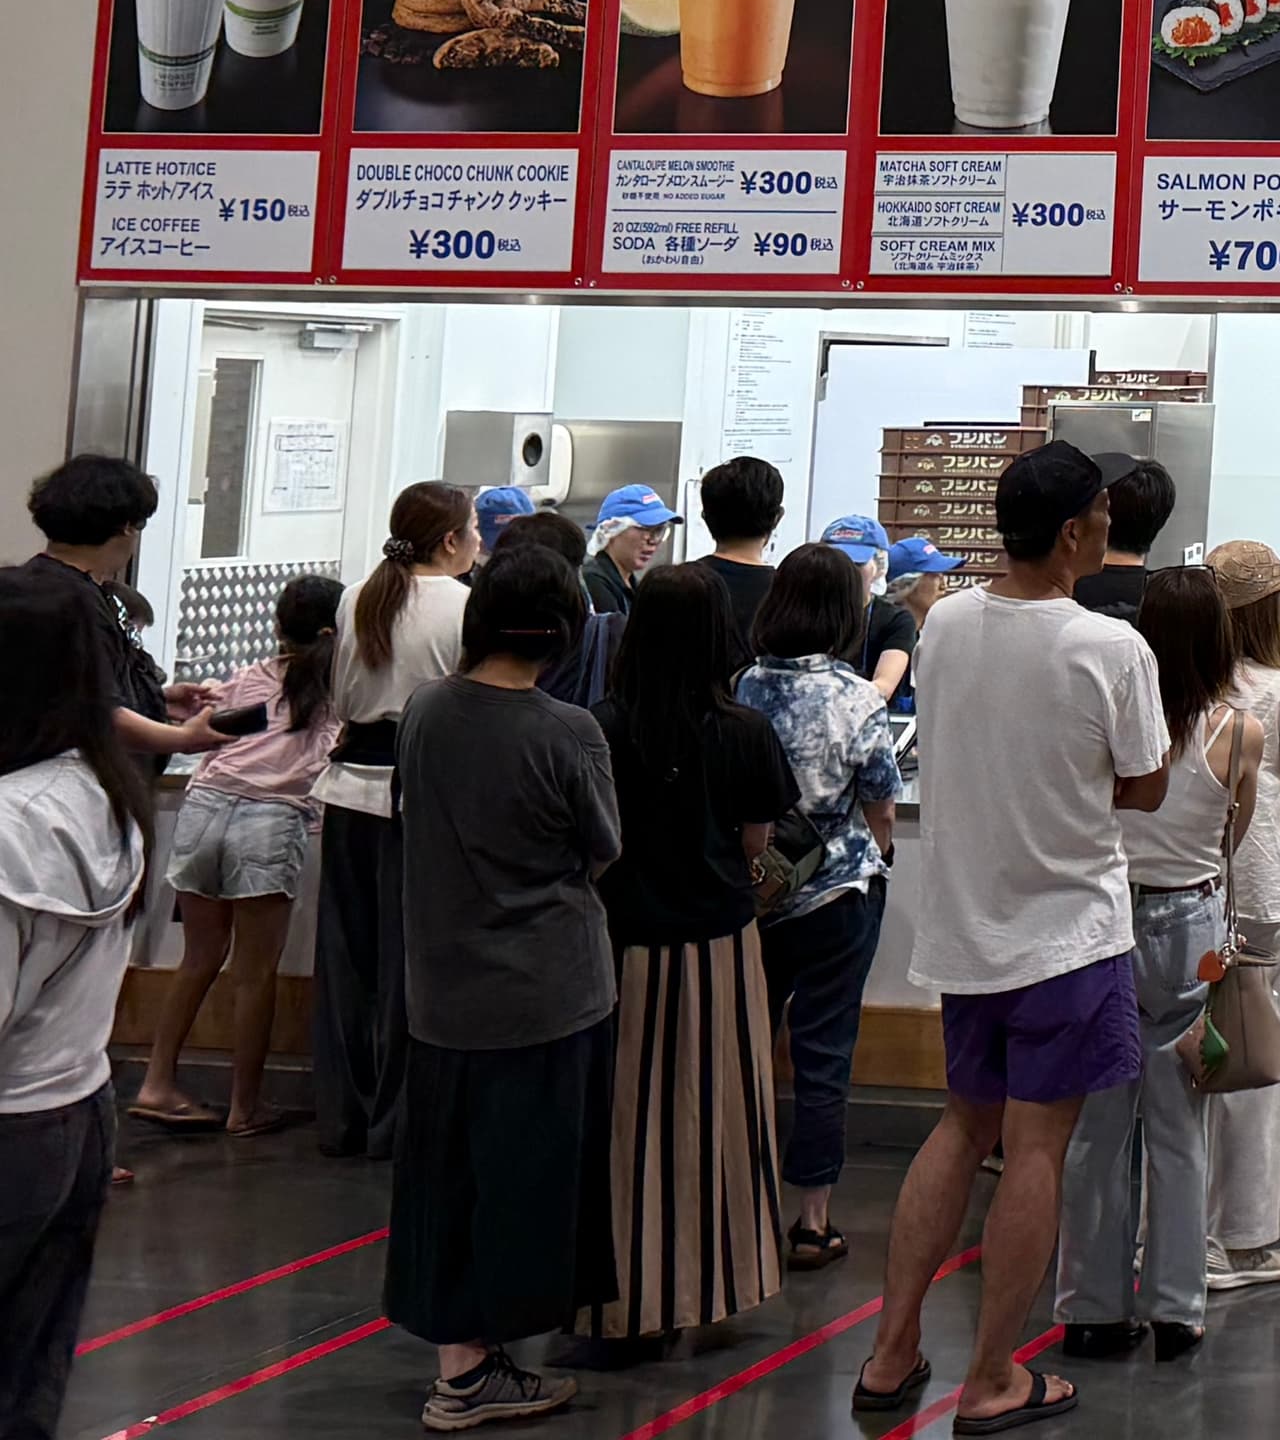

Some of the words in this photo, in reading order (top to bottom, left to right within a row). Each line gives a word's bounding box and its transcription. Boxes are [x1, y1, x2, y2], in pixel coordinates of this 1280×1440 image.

[106, 162, 151, 175] LATTE
[156, 162, 216, 175] HOT/ICE
[617, 160, 666, 171] CANTALOUPE
[668, 160, 694, 171] MELON
[696, 161, 734, 171] SMOOTHIE
[880, 161, 926, 171] MATCHA
[930, 161, 958, 172] SOFT
[962, 161, 1001, 172] CREAM
[357, 165, 411, 181] DOUBLE
[415, 165, 463, 181] CHOCO
[467, 165, 513, 181] CHUNK
[518, 165, 568, 181] COOKIE
[616, 174, 734, 187] カンタロープメロンスムージー
[884, 174, 996, 186] 宇治抹茶ソフトクリーム
[1158, 174, 1245, 190] SALMON
[105, 181, 132, 199] ラテ
[137, 181, 213, 200] ホット/アイス
[357, 189, 567, 211] ダブルチョコチャンククッキー
[878, 201, 932, 213] HOKKAIDO
[935, 202, 961, 213] SOFT
[964, 202, 1000, 213] CREAM
[112, 218, 136, 231] ICE
[141, 218, 200, 232] COFFEE
[888, 215, 989, 227] 北海道ソフトクリーム
[613, 222, 623, 232] 20
[675, 223, 701, 233] FREE
[704, 223, 738, 234] REFILL
[101, 237, 210, 256] アイスコーヒー
[613, 237, 655, 250] SODA
[665, 236, 739, 252] 各種ソーダ
[880, 240, 915, 251] SOFT
[920, 241, 967, 251] CREAM
[972, 240, 996, 252] MIX
[890, 252, 984, 261] ソフトクリームミックス
[1114, 373, 1160, 384] フジパン
[949, 432, 1007, 444] フジパン
[942, 455, 1004, 468] フジパン
[937, 527, 1000, 540] フジパン
